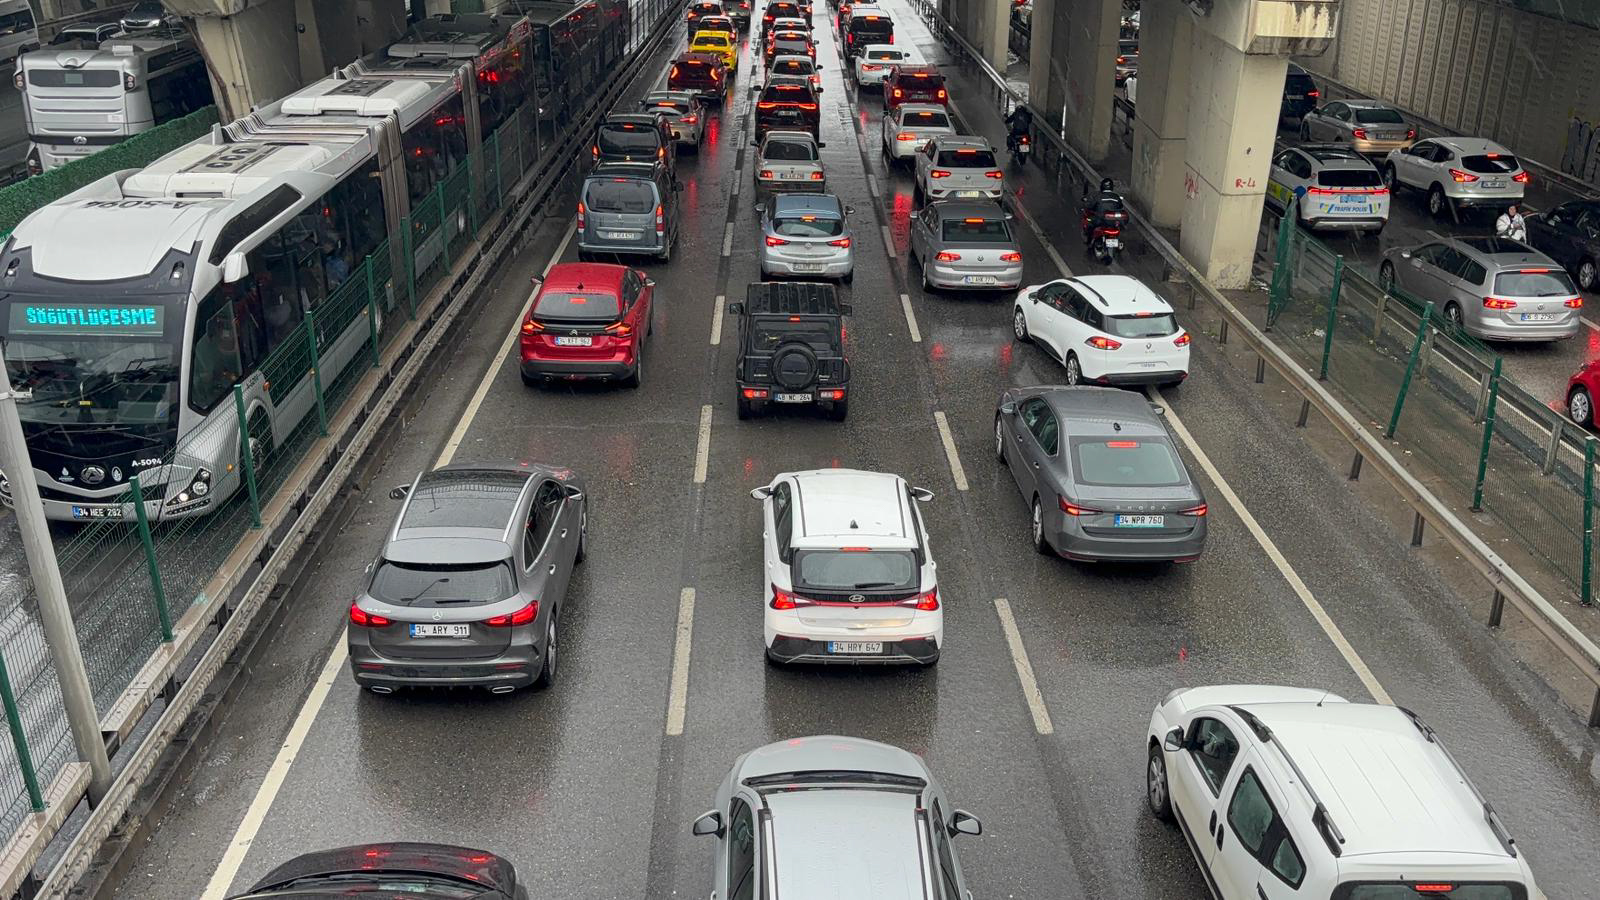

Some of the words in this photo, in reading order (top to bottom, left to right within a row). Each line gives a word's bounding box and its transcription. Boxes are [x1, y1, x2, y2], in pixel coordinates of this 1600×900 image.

[131, 458, 162, 467] A-5094
[78, 507, 88, 516] 34
[416, 626, 426, 634] 34
[433, 626, 448, 634] ARY
[454, 626, 468, 634] 911
[835, 643, 844, 651] 34
[847, 643, 862, 651] HRY
[865, 643, 881, 651] 647
